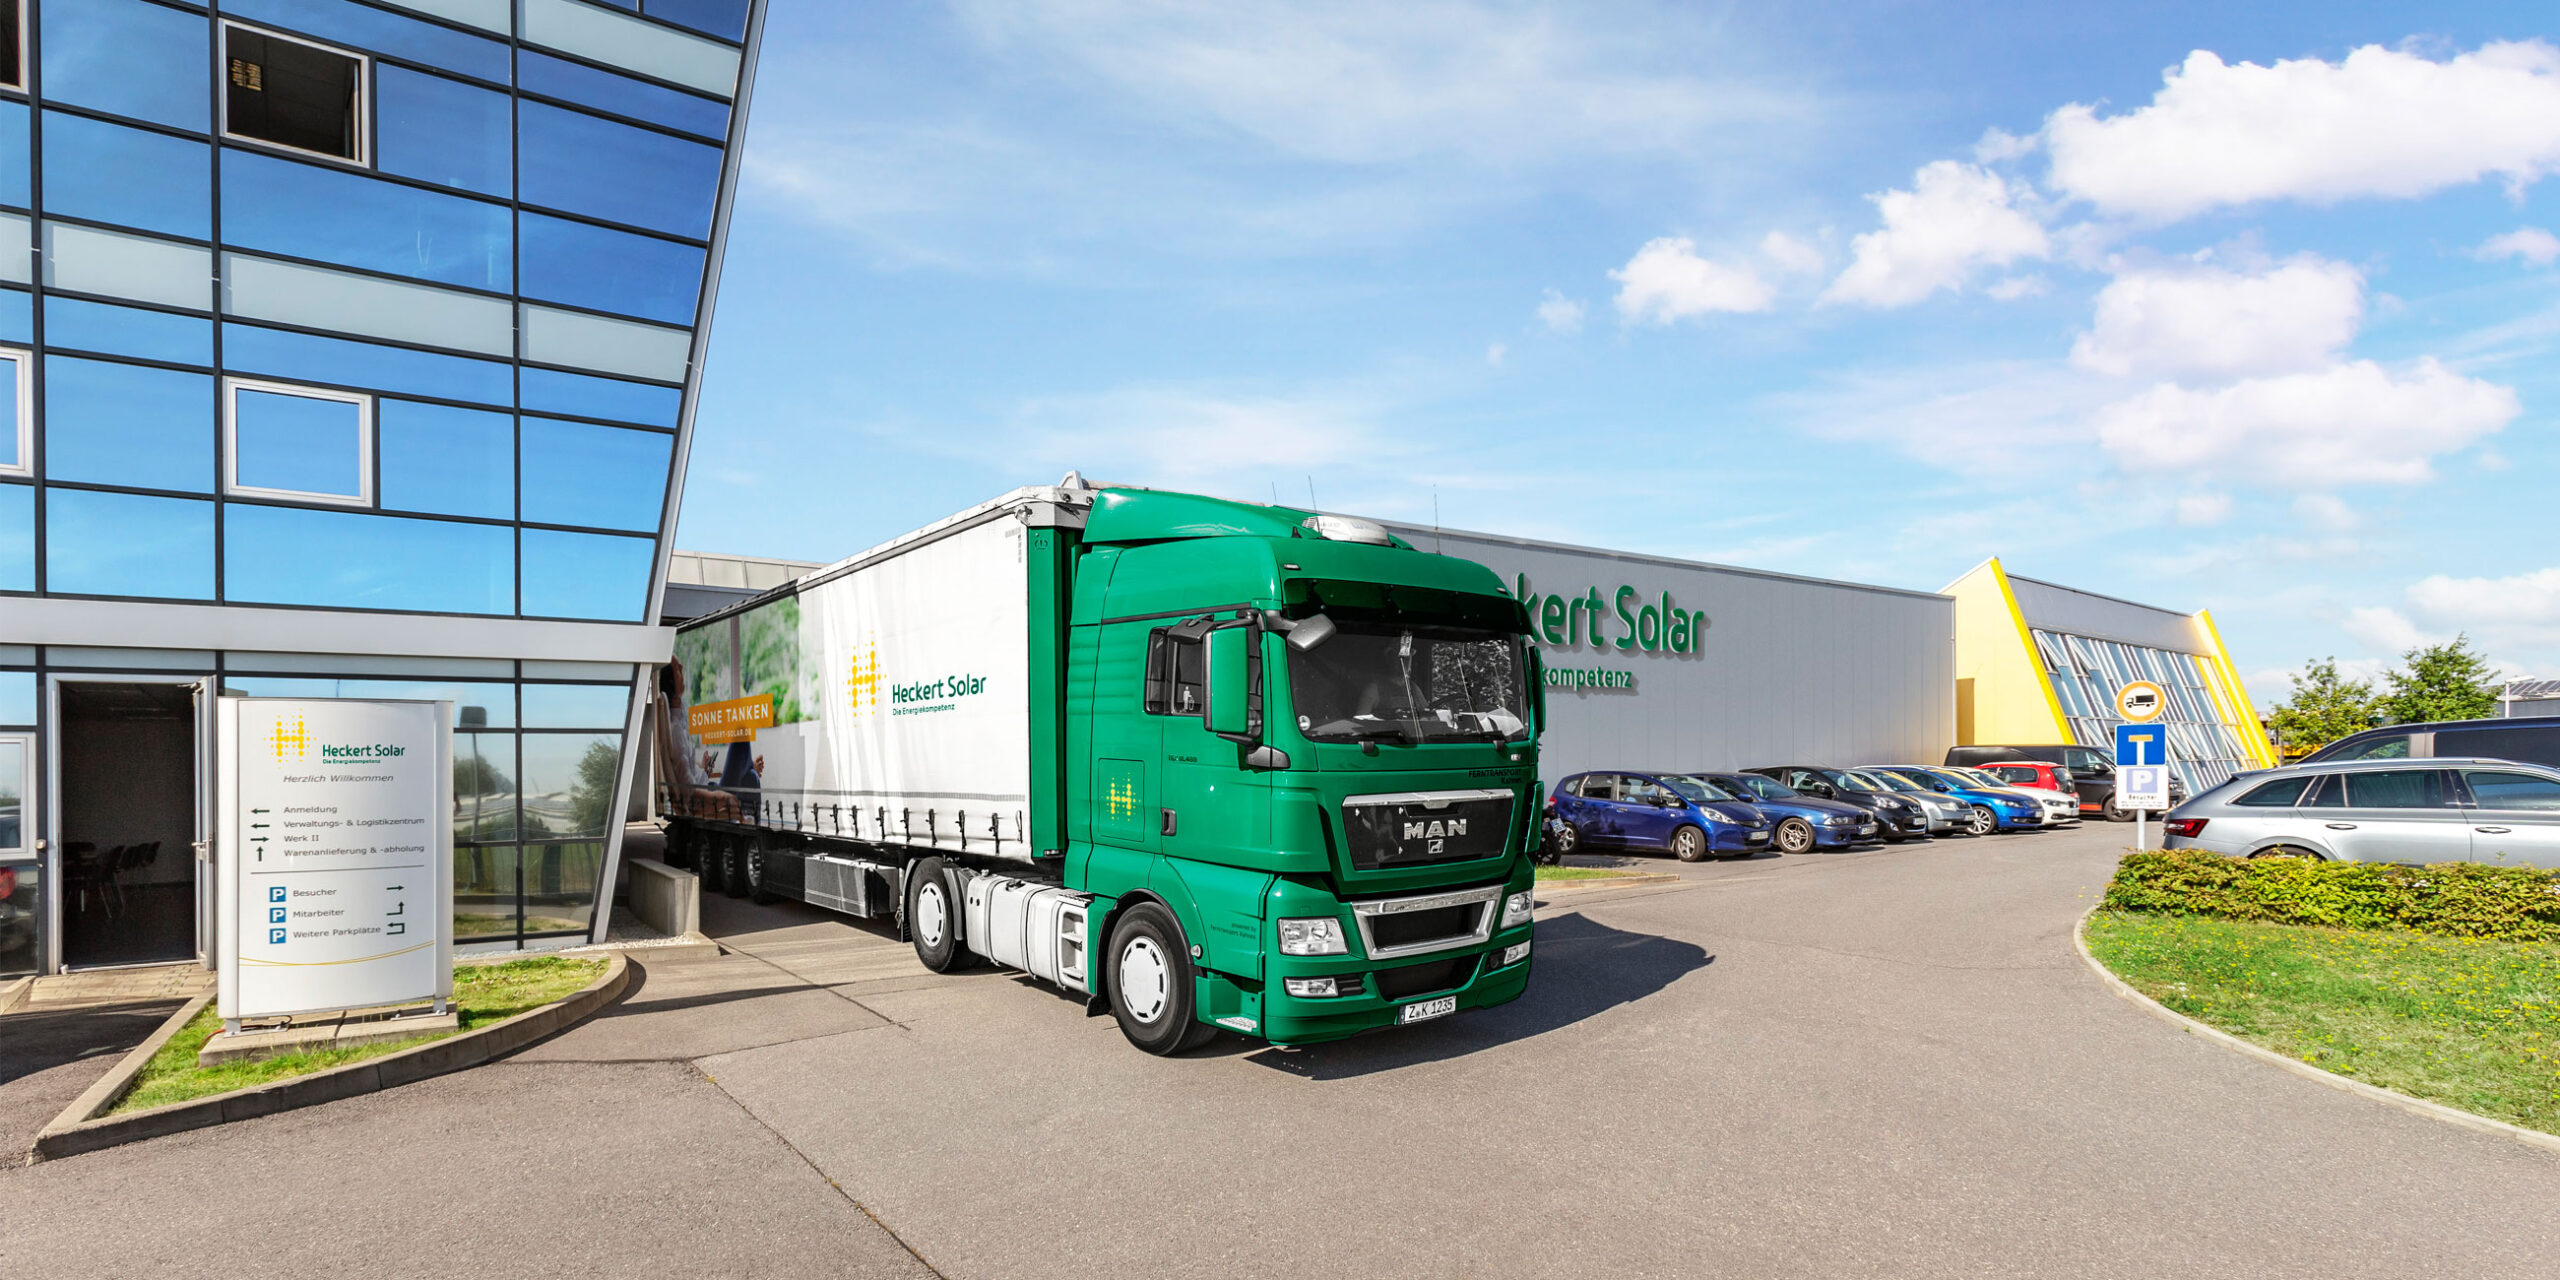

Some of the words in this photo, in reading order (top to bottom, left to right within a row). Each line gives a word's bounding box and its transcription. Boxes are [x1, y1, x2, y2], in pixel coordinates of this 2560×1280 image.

[1514, 572, 1604, 647] kert
[1614, 585, 1704, 653] Solar
[1543, 666, 1632, 691] ompetenz
[892, 679, 944, 704] Heckert
[948, 673, 987, 698] Solar
[691, 710, 723, 727] SONNE
[726, 703, 768, 723] TANKEN
[892, 708, 901, 716] Die
[902, 704, 955, 715] Energiekompetenz
[322, 744, 372, 757] Heckert
[375, 744, 405, 757] Solar
[283, 775, 326, 783] Herzlich
[330, 774, 394, 782] Willkommen
[283, 806, 338, 814] Anmeldung
[284, 820, 343, 828] Verwaltungs-
[356, 818, 424, 827] Logistikzentrum
[1403, 818, 1467, 840] MAN
[312, 834, 319, 842] II
[284, 847, 367, 857] Warenanlieferung
[380, 845, 425, 853] -abholung
[272, 888, 285, 901] P
[292, 889, 337, 897] Besucher
[272, 909, 285, 922] P
[292, 909, 345, 918] Mitarbeiter
[272, 930, 285, 943] P
[292, 930, 330, 939] Weitere
[1408, 1005, 1416, 1018] Z
[1421, 1003, 1428, 1016] K
[1430, 998, 1453, 1014] 1235
